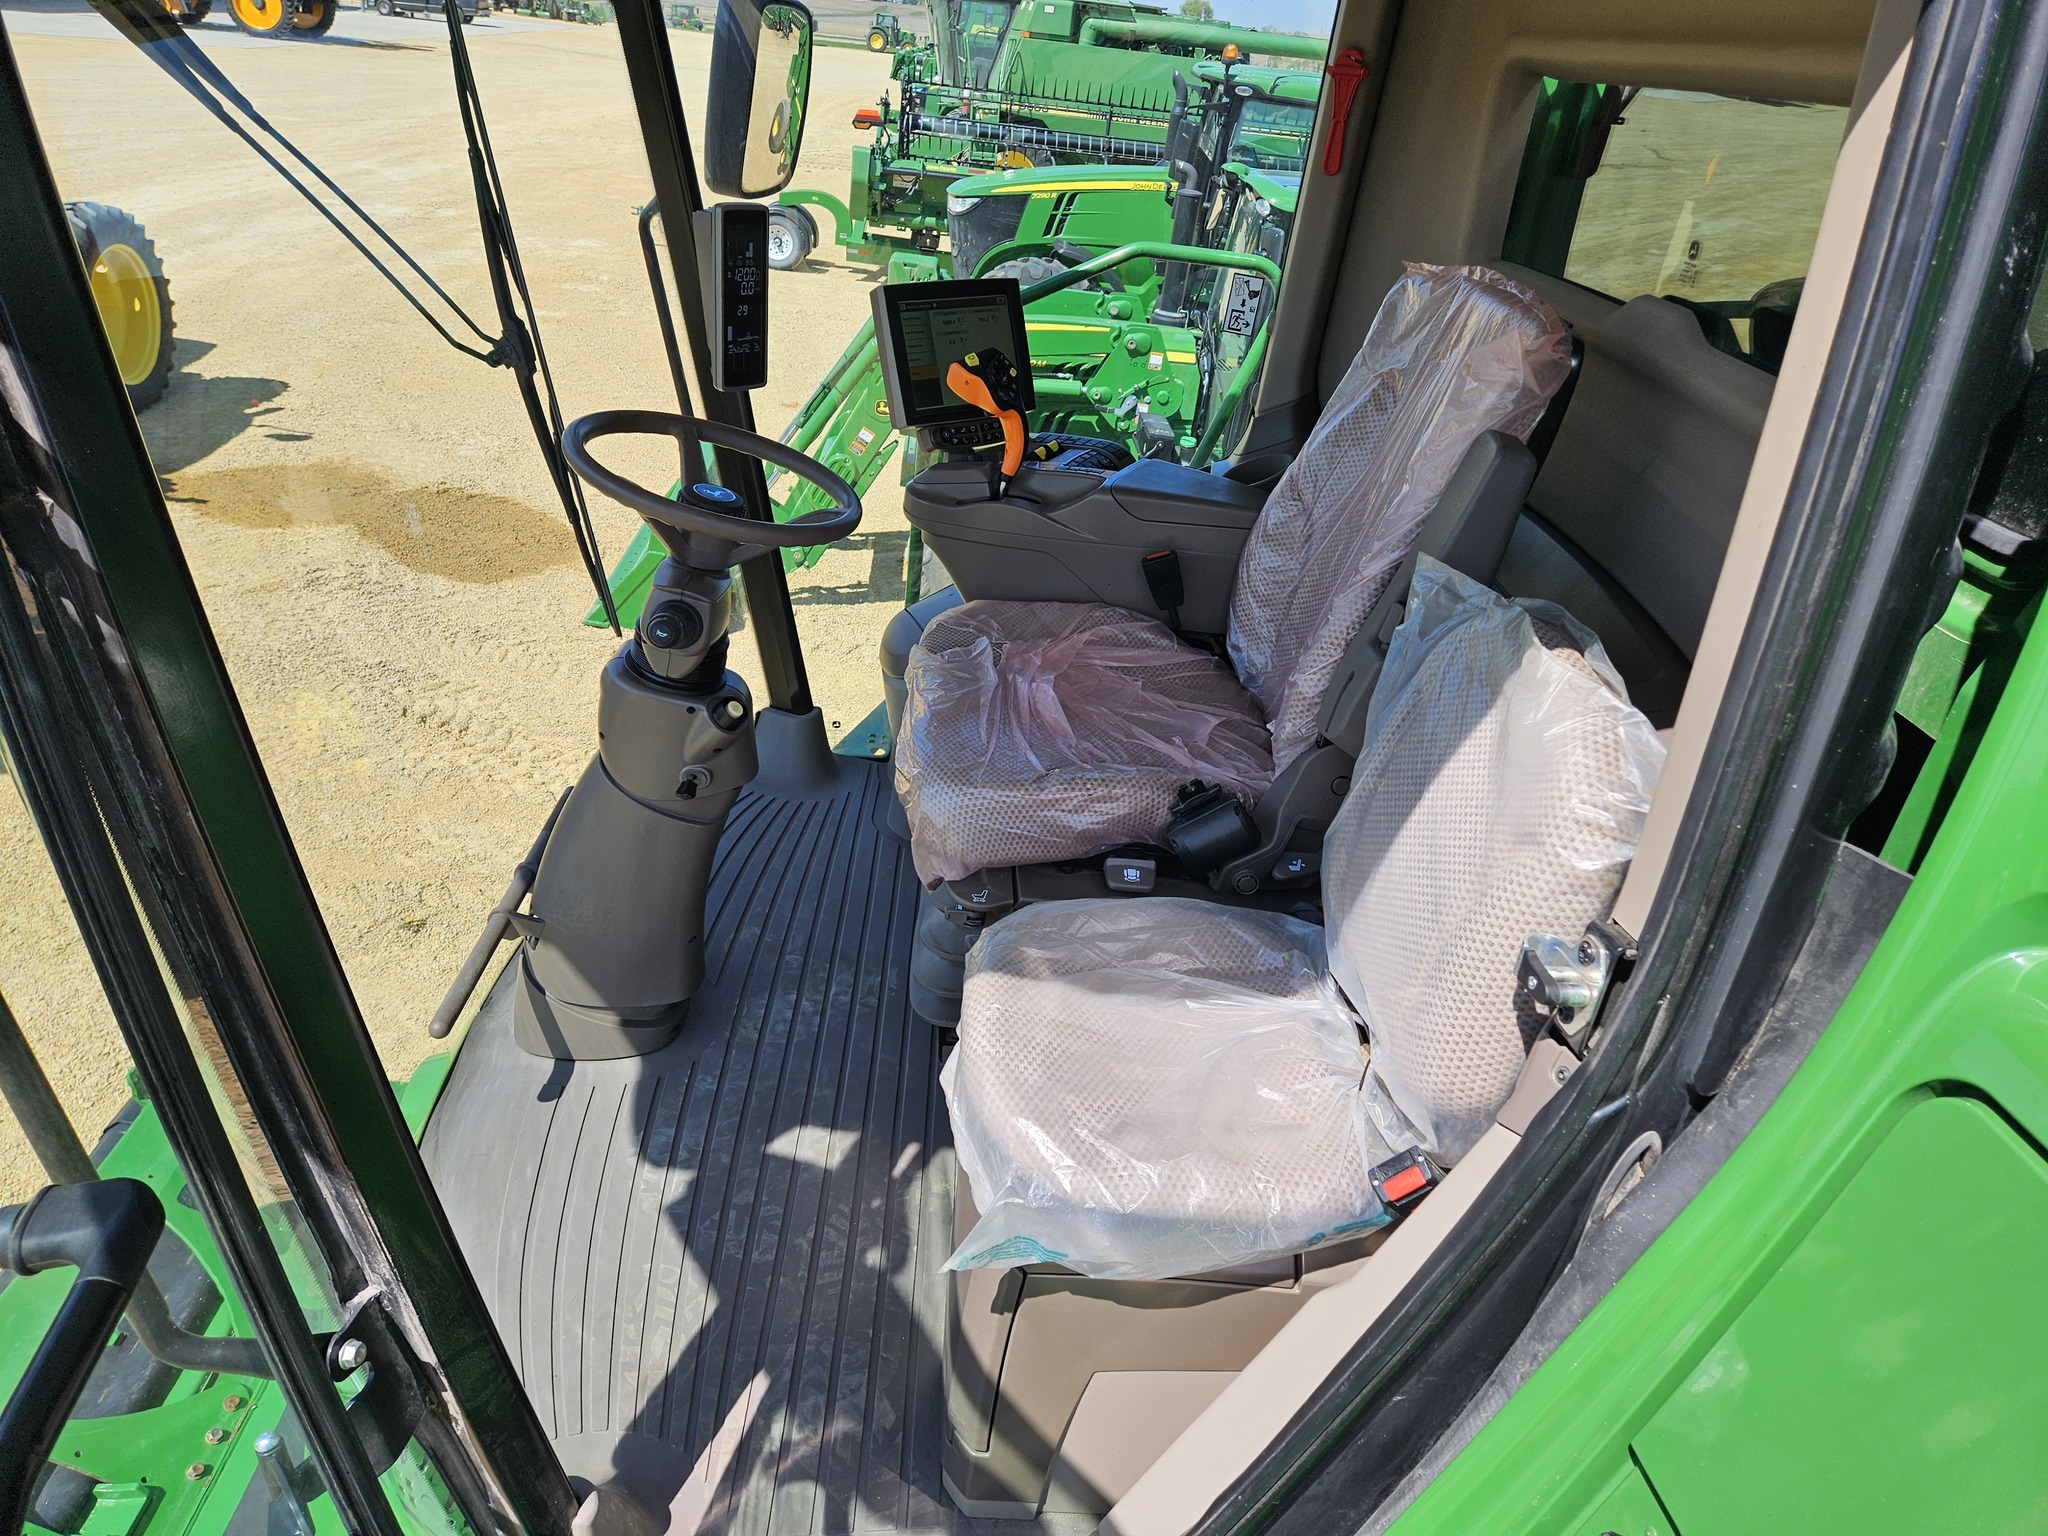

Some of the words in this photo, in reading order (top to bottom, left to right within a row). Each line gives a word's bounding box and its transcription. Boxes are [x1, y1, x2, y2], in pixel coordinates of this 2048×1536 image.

[1131, 182, 1152, 190] JOHN
[734, 267, 756, 282] 1200
[740, 282, 755, 296] 0.0
[737, 305, 749, 316] 29
